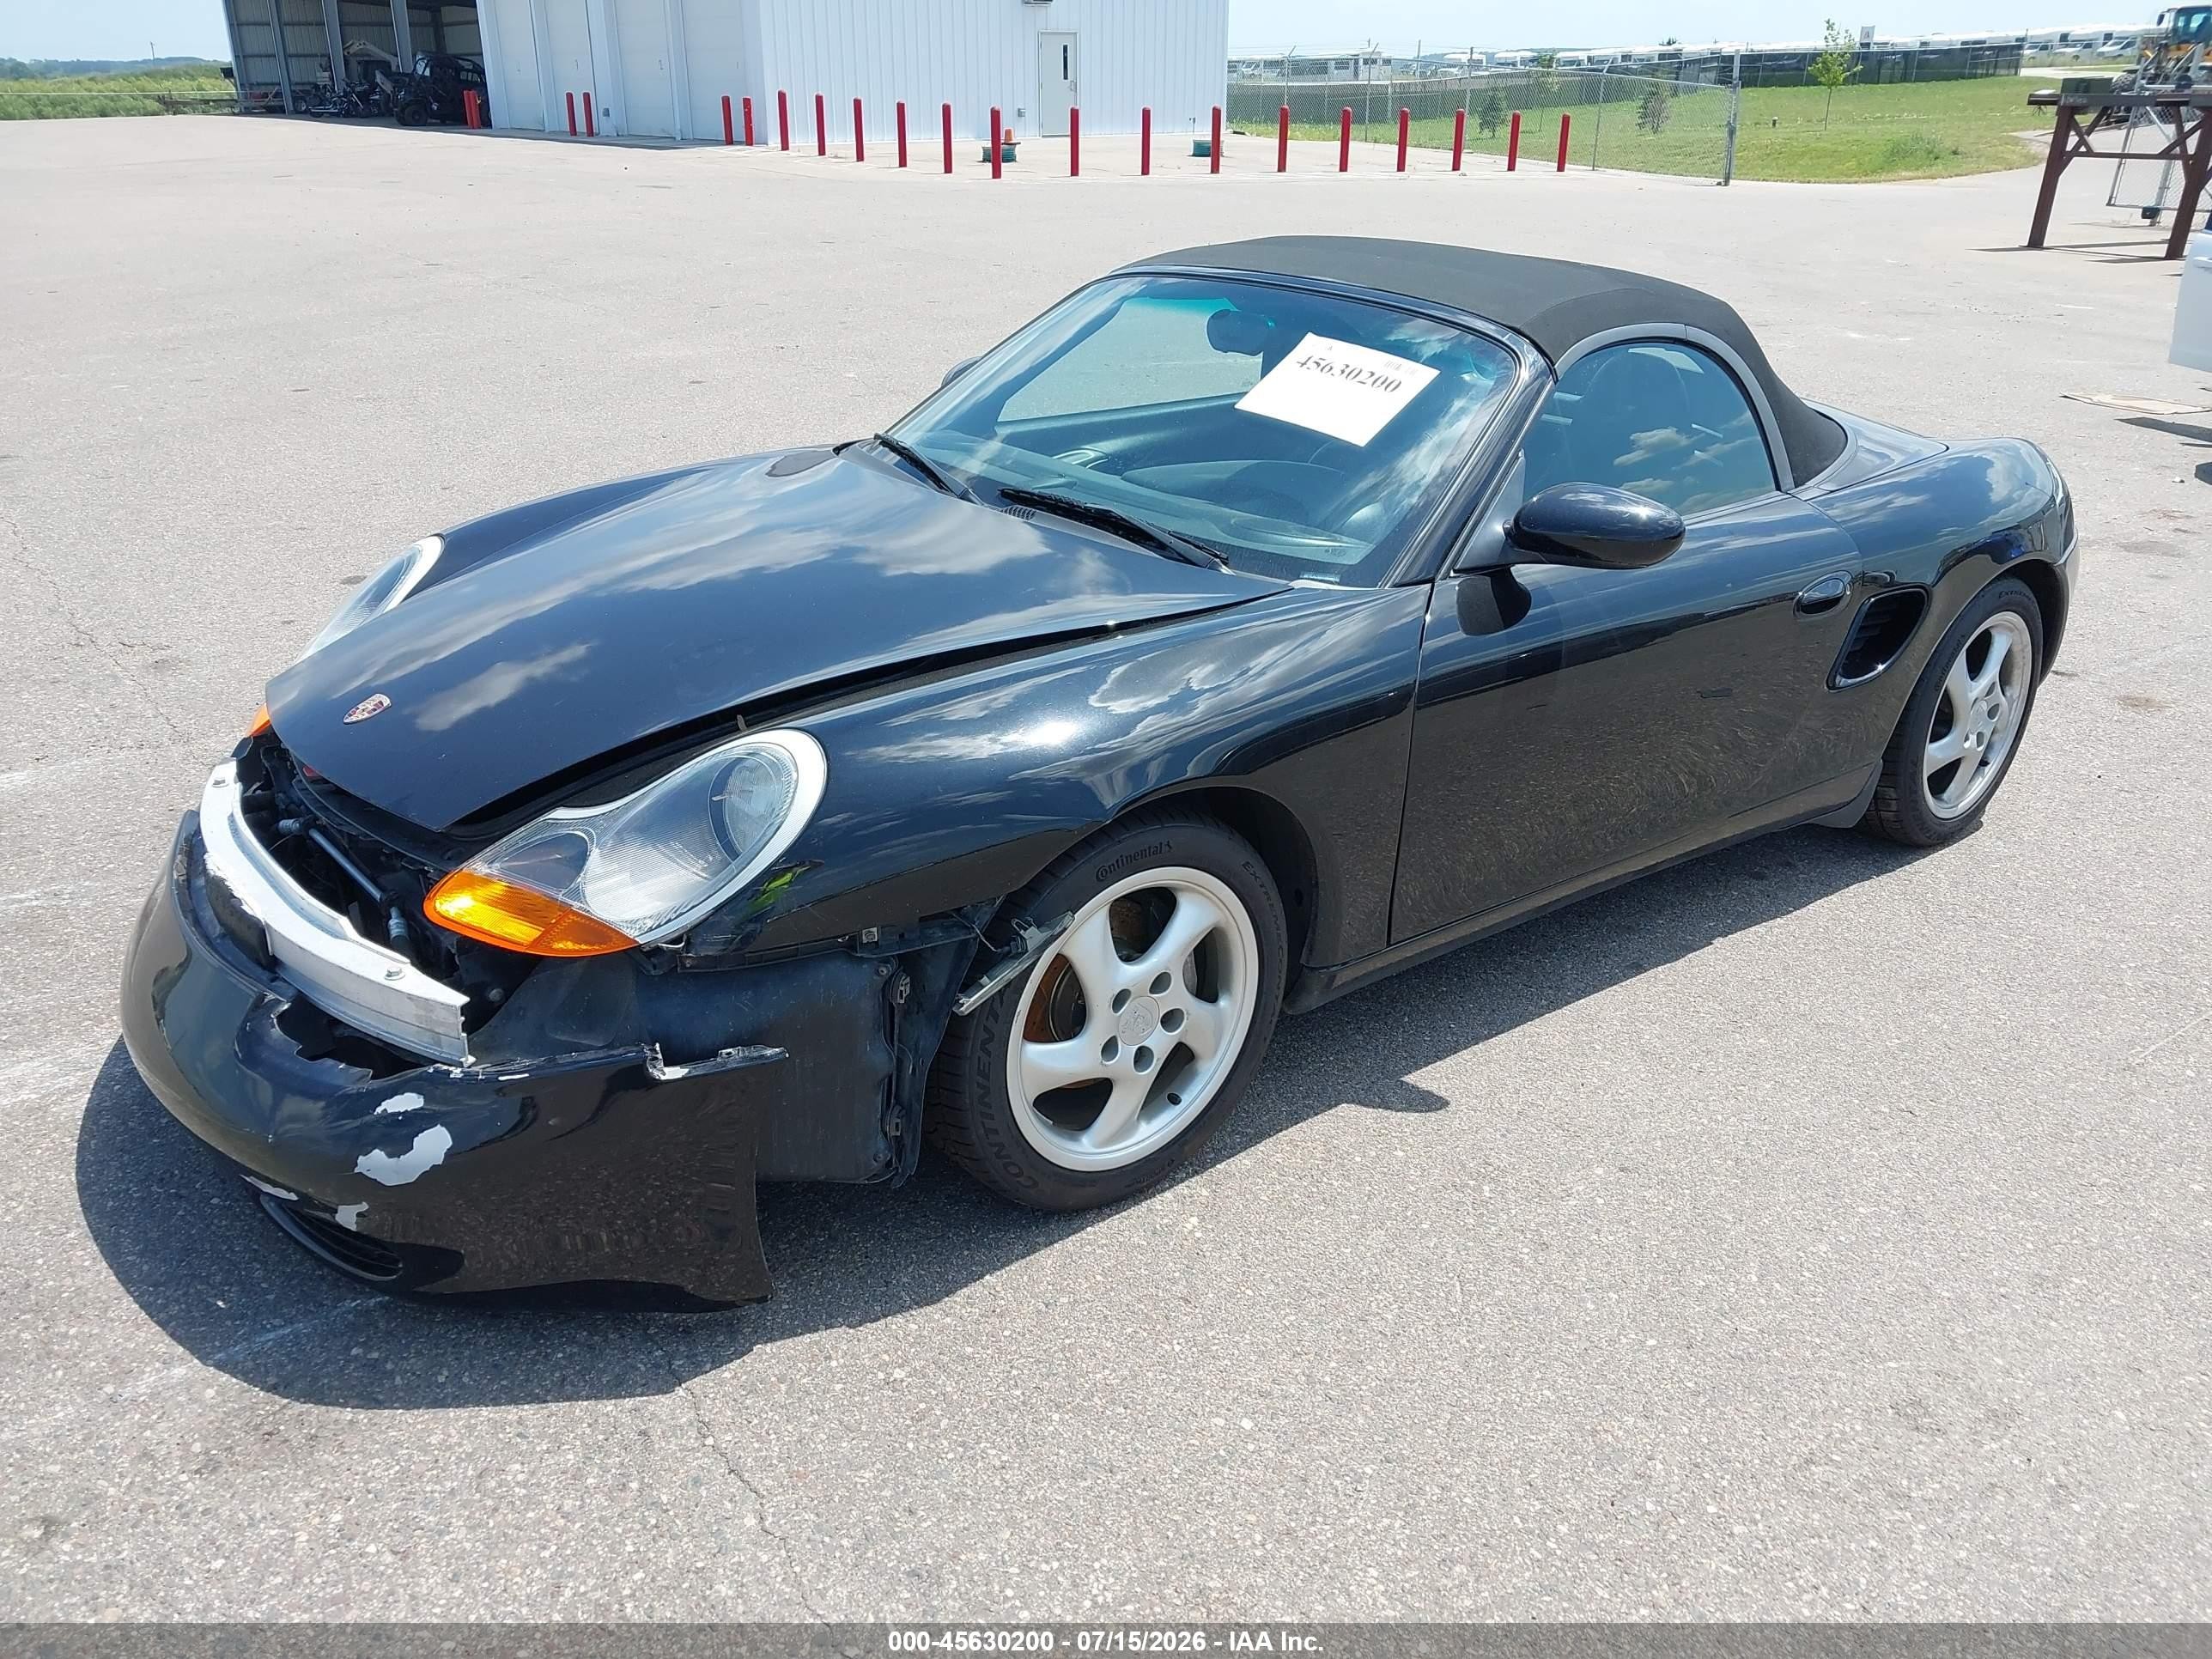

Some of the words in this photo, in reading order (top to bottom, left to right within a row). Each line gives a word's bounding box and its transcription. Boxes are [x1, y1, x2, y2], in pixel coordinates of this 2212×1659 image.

[1297, 356, 1401, 392] 45630200
[1095, 842, 1163, 882] Continental
[975, 988, 1039, 1189] CONTINENTA
